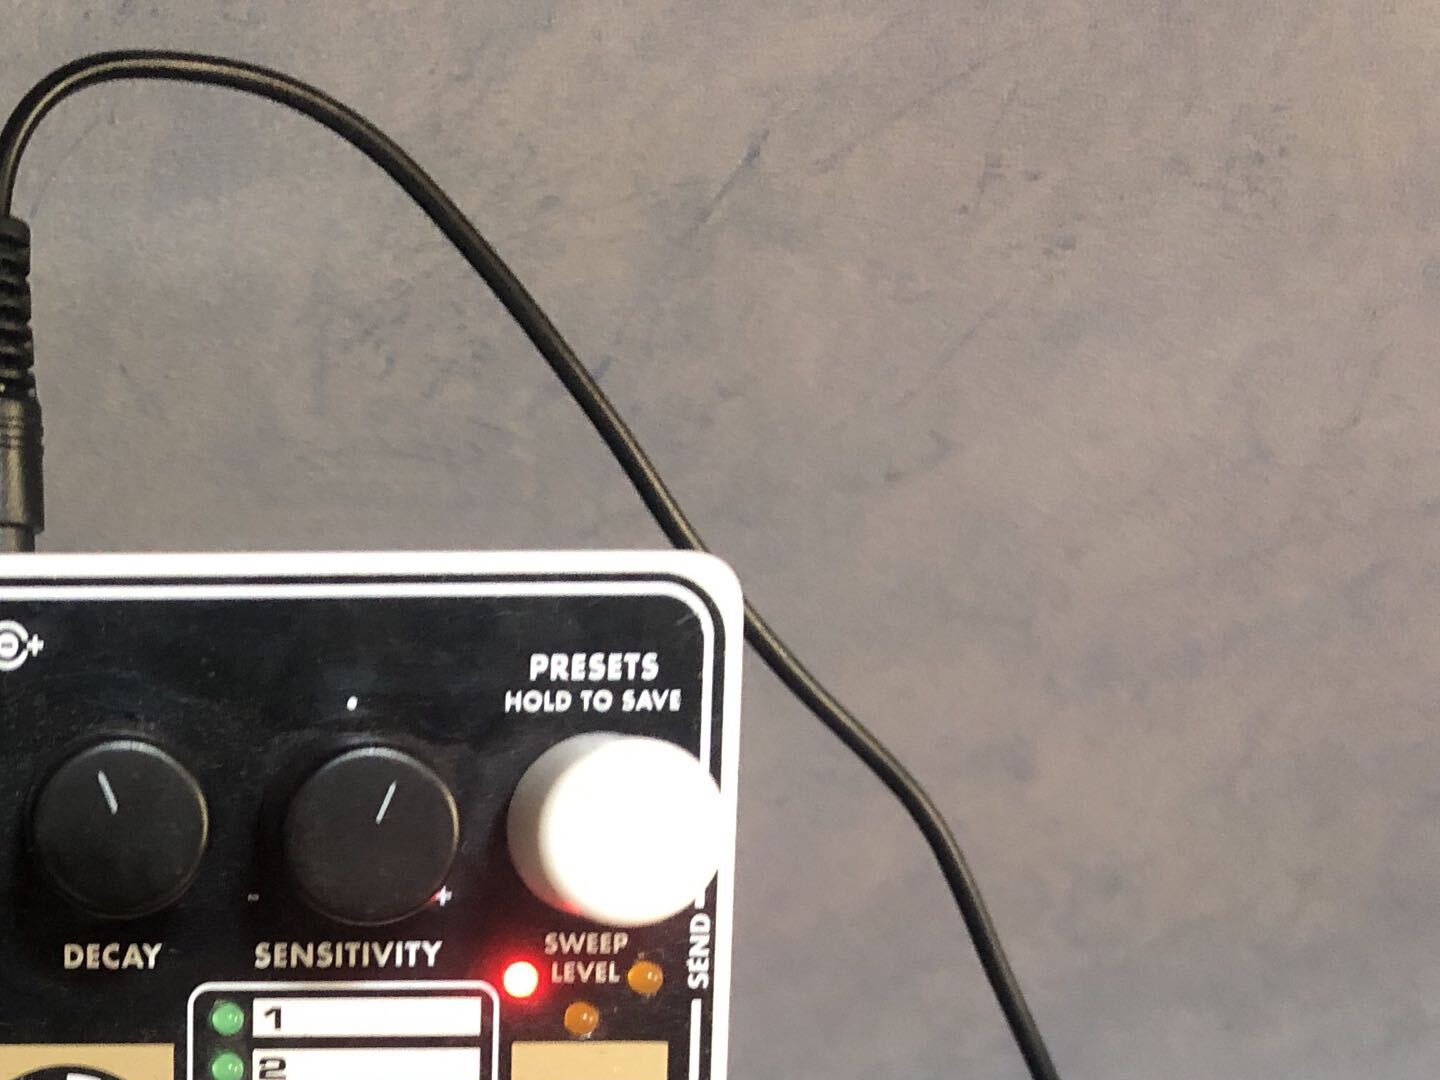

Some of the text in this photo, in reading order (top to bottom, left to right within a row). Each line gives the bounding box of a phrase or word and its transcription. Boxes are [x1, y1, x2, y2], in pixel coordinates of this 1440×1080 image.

[529, 652, 659, 682] PRESETS
[504, 688, 682, 713] HOLD TO SAVE
[254, 940, 443, 969] SENSITIVITY
[544, 931, 629, 955] SWEEP
[688, 912, 711, 990] SEND
[63, 942, 163, 970] DECAY
[551, 960, 621, 984] LEVEL
[264, 1007, 282, 1030] 1
[258, 1057, 287, 1080] 2
